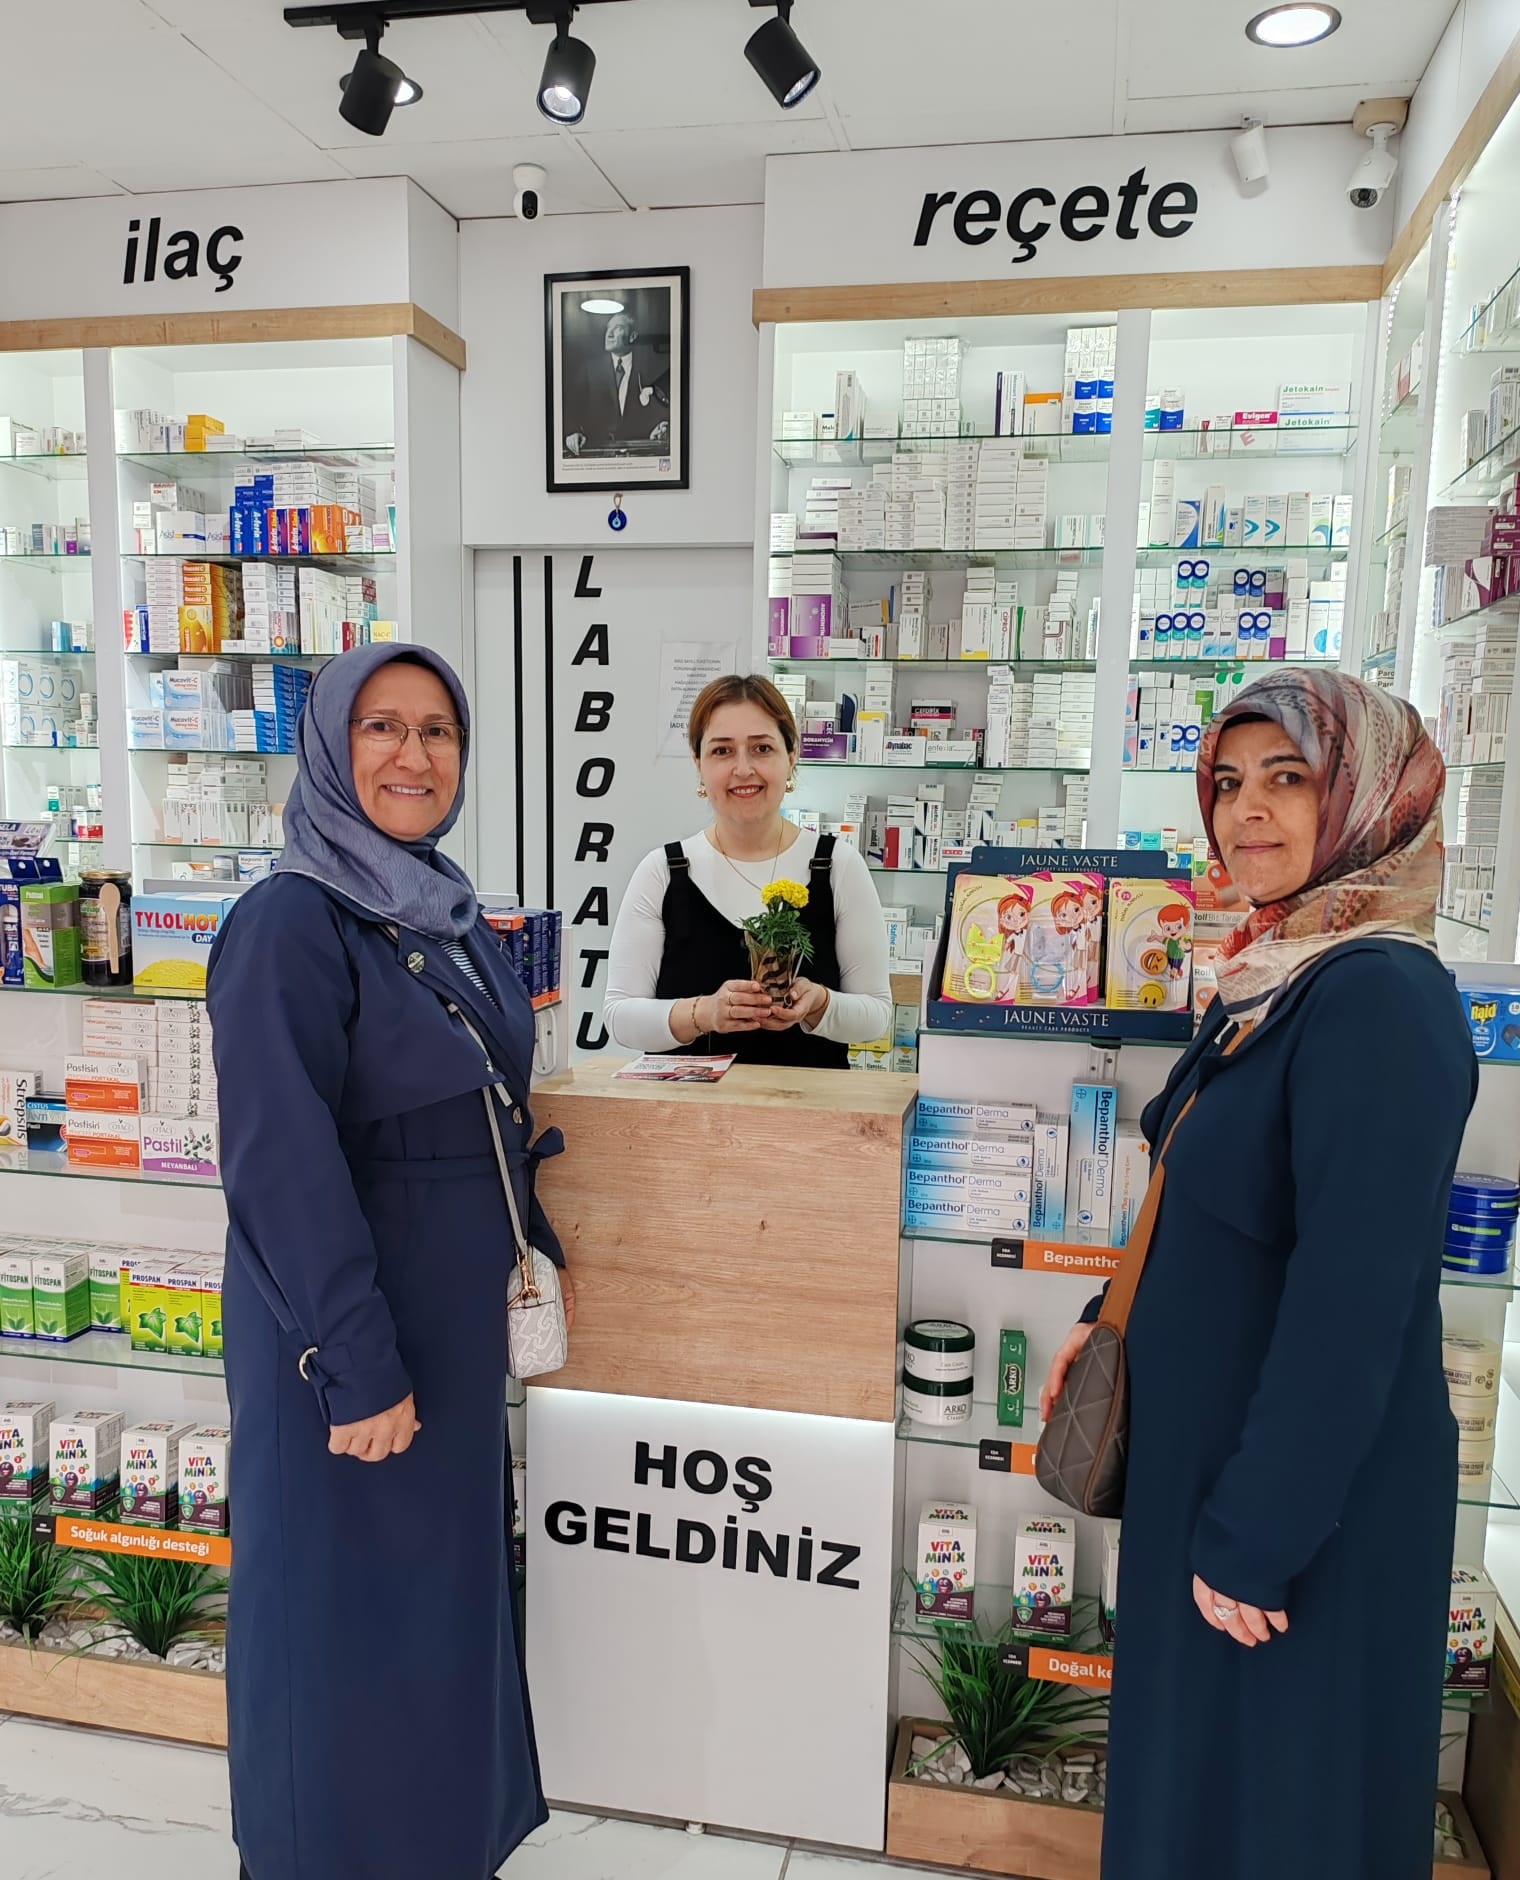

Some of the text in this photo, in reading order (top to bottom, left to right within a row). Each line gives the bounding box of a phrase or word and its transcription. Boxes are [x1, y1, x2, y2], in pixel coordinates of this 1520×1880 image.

[913, 166, 1198, 263] reçete
[123, 217, 244, 292] ilaç
[1283, 385, 1324, 393] Jetokain
[1285, 418, 1330, 426] Jetokain
[1020, 854, 1118, 868] JAUNE VASTE
[195, 934, 213, 943] DAY
[1004, 1009, 1109, 1027] JAUNE VASTE
[1471, 1003, 1497, 1020] Raid
[14, 1078, 28, 1140] Strepsils
[919, 1102, 1009, 1118] Bepanthol Derma
[1098, 1090, 1113, 1156] Bepanthol
[143, 1136, 183, 1154] Pastil
[912, 1137, 1005, 1153] Bepanthol Derma
[161, 1161, 198, 1171] MEYANBALI
[909, 1171, 1002, 1188] Bepanthol Derma
[1095, 1159, 1109, 1197] Derma
[1033, 1148, 1045, 1228] Bepanthol Derma
[907, 1199, 1000, 1216] Bepanthol Derma
[132, 1274, 161, 1283] PROSPAN
[168, 1278, 197, 1287] PROSPAN
[944, 1403, 967, 1414] ARKO
[634, 1440, 773, 1513] HOŞ
[70, 1526, 108, 1543] Soğuk
[110, 1531, 160, 1551] algınlığı
[162, 1538, 210, 1556] desteği
[544, 1500, 861, 1590] GELDİNİZ
[1049, 1658, 1093, 1678] Doğal
